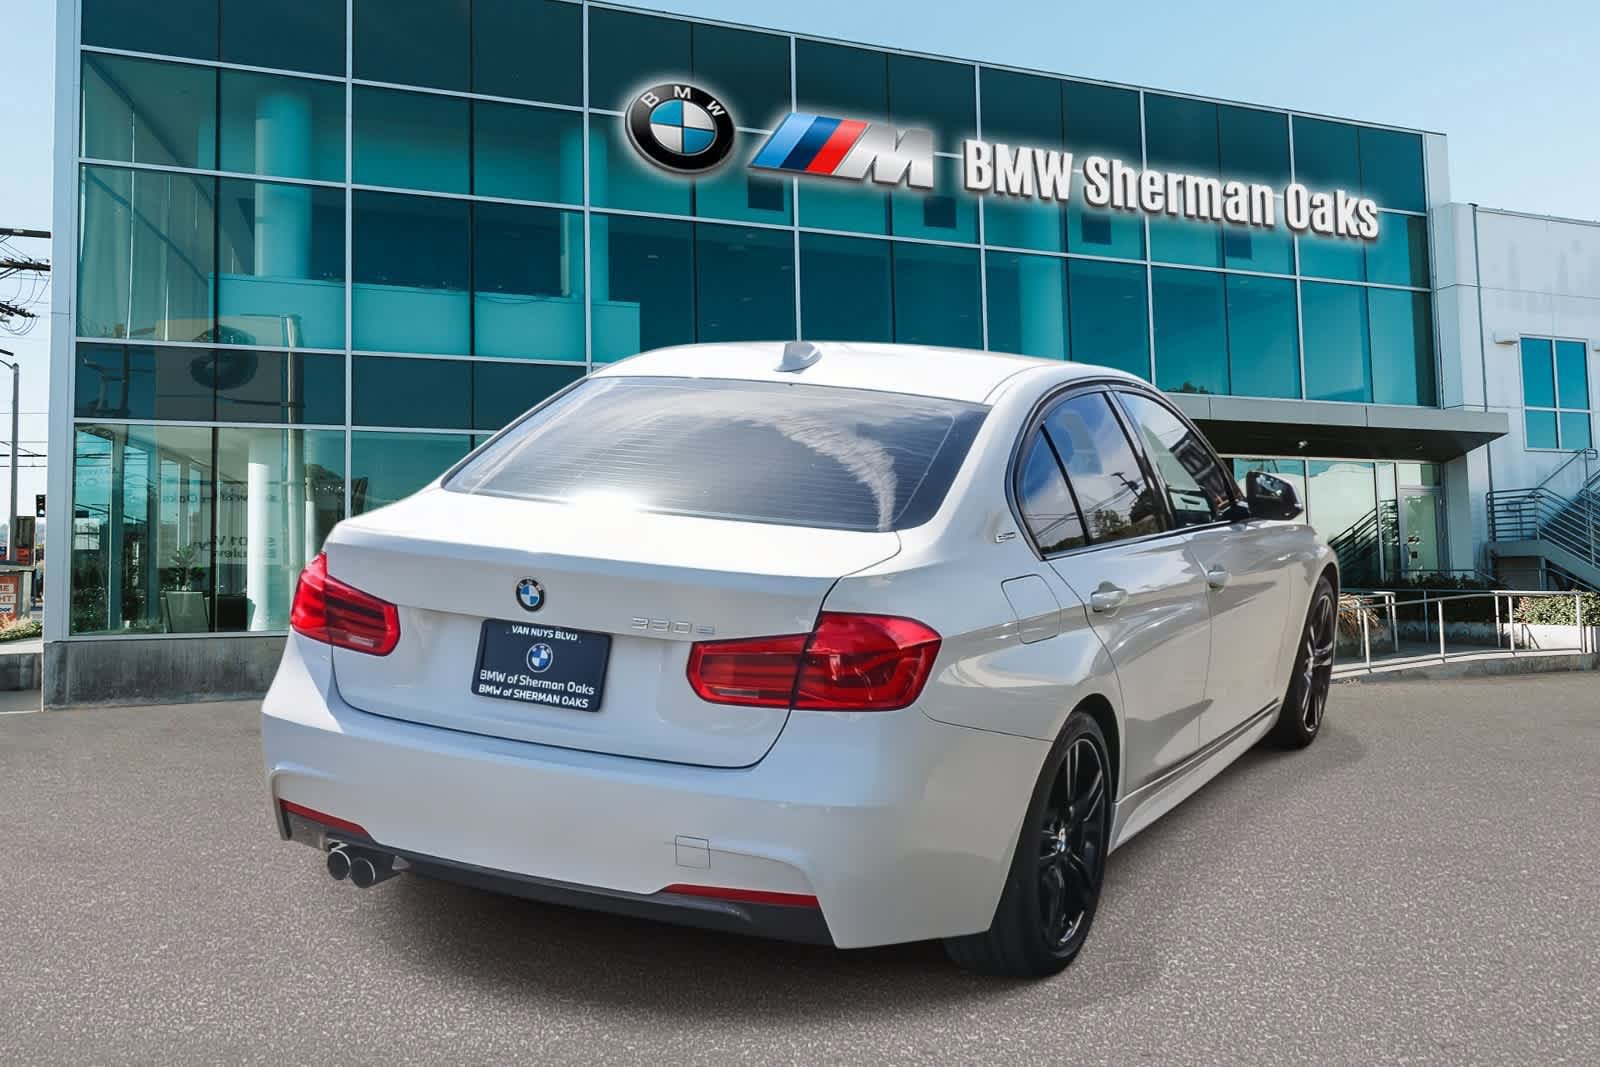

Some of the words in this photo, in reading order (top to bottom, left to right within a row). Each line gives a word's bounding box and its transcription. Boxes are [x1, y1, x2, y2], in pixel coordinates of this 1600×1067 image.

[641, 85, 726, 118] BMW
[964, 138, 1073, 203] BMW
[1084, 156, 1276, 228] Sherman
[1285, 183, 1380, 241] Oaks
[511, 624, 530, 635] VAN
[530, 629, 554, 639] NUYS
[480, 669, 506, 684] BMW
[507, 674, 519, 685] of
[519, 675, 565, 691] Sherman
[567, 681, 595, 696] Oaks
[478, 684, 502, 696] BMW
[503, 689, 513, 698] of
[513, 689, 560, 705] SHERMAN
[561, 696, 589, 709] OAKS
